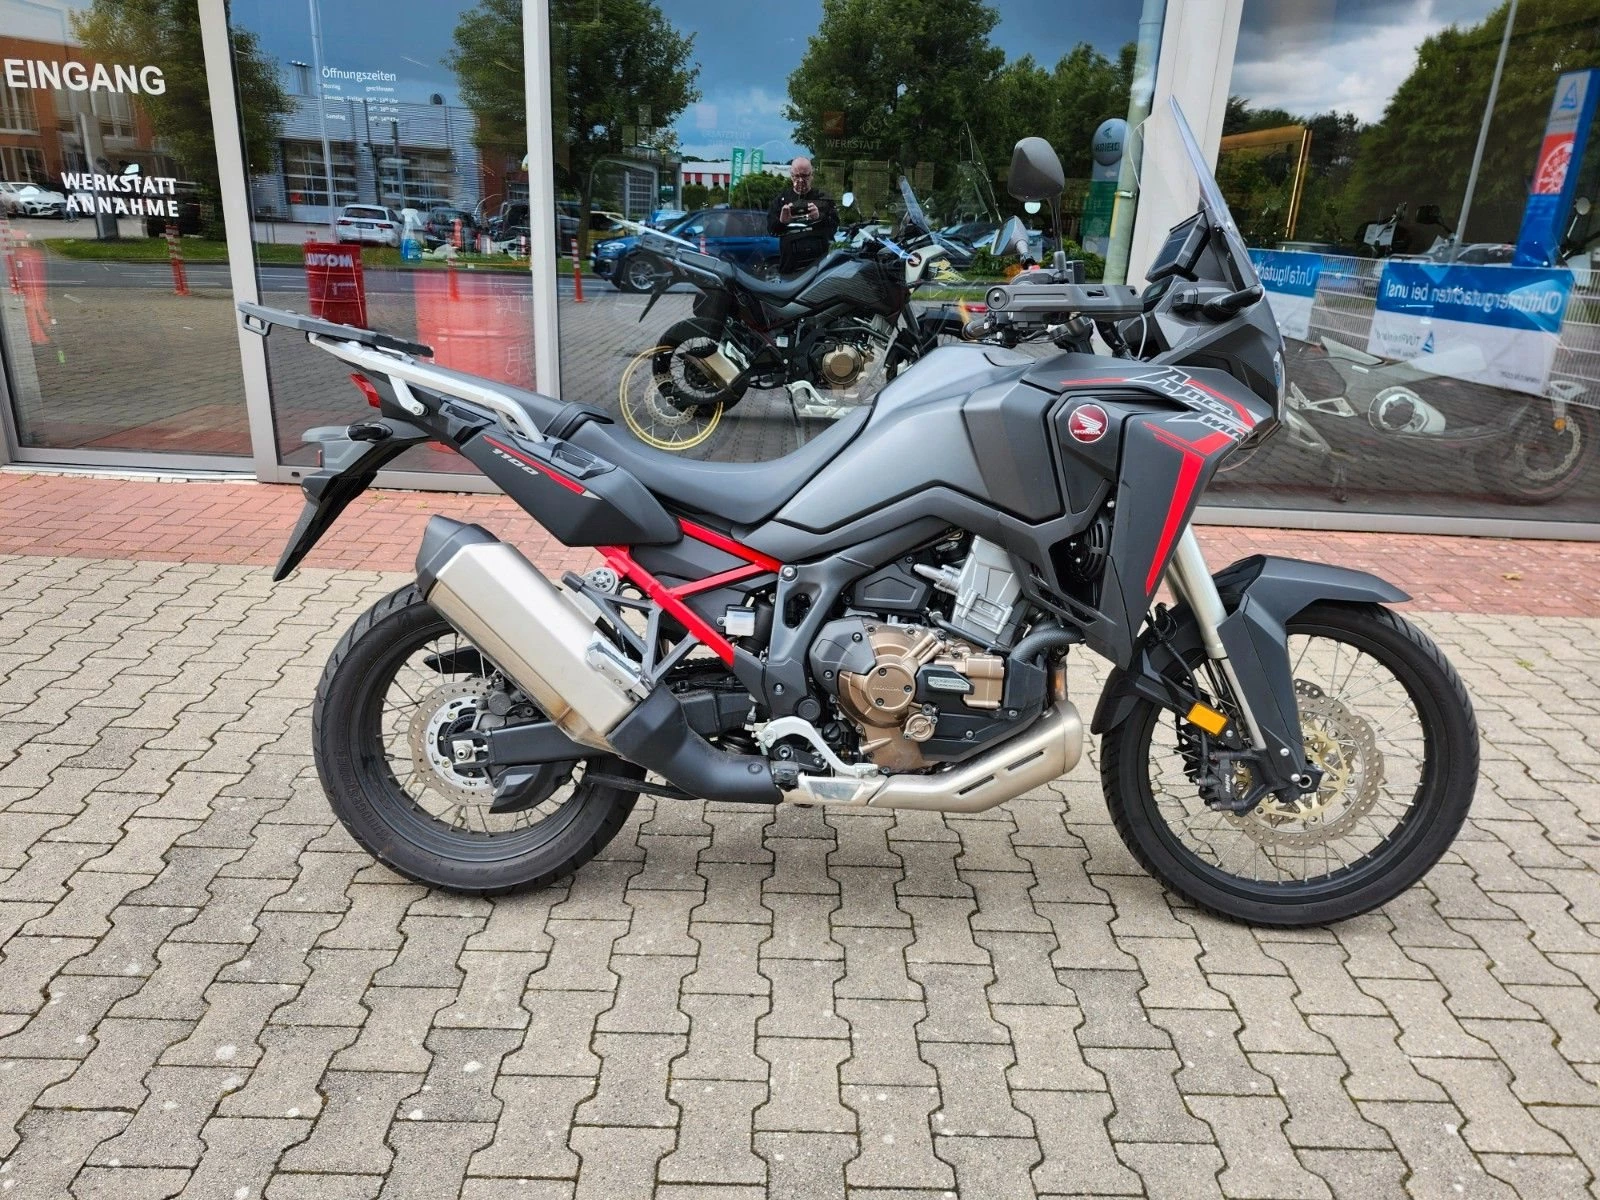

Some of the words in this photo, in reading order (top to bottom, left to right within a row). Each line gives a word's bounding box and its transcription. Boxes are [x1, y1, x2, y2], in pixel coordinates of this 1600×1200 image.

[4, 58, 166, 96] EINGANG
[322, 65, 397, 83] Öffnungszeiten
[825, 138, 881, 150] WERKSTATT
[61, 171, 177, 196] WERKSTATT
[66, 194, 179, 218] ANNAHME
[492, 448, 539, 476] 1100
